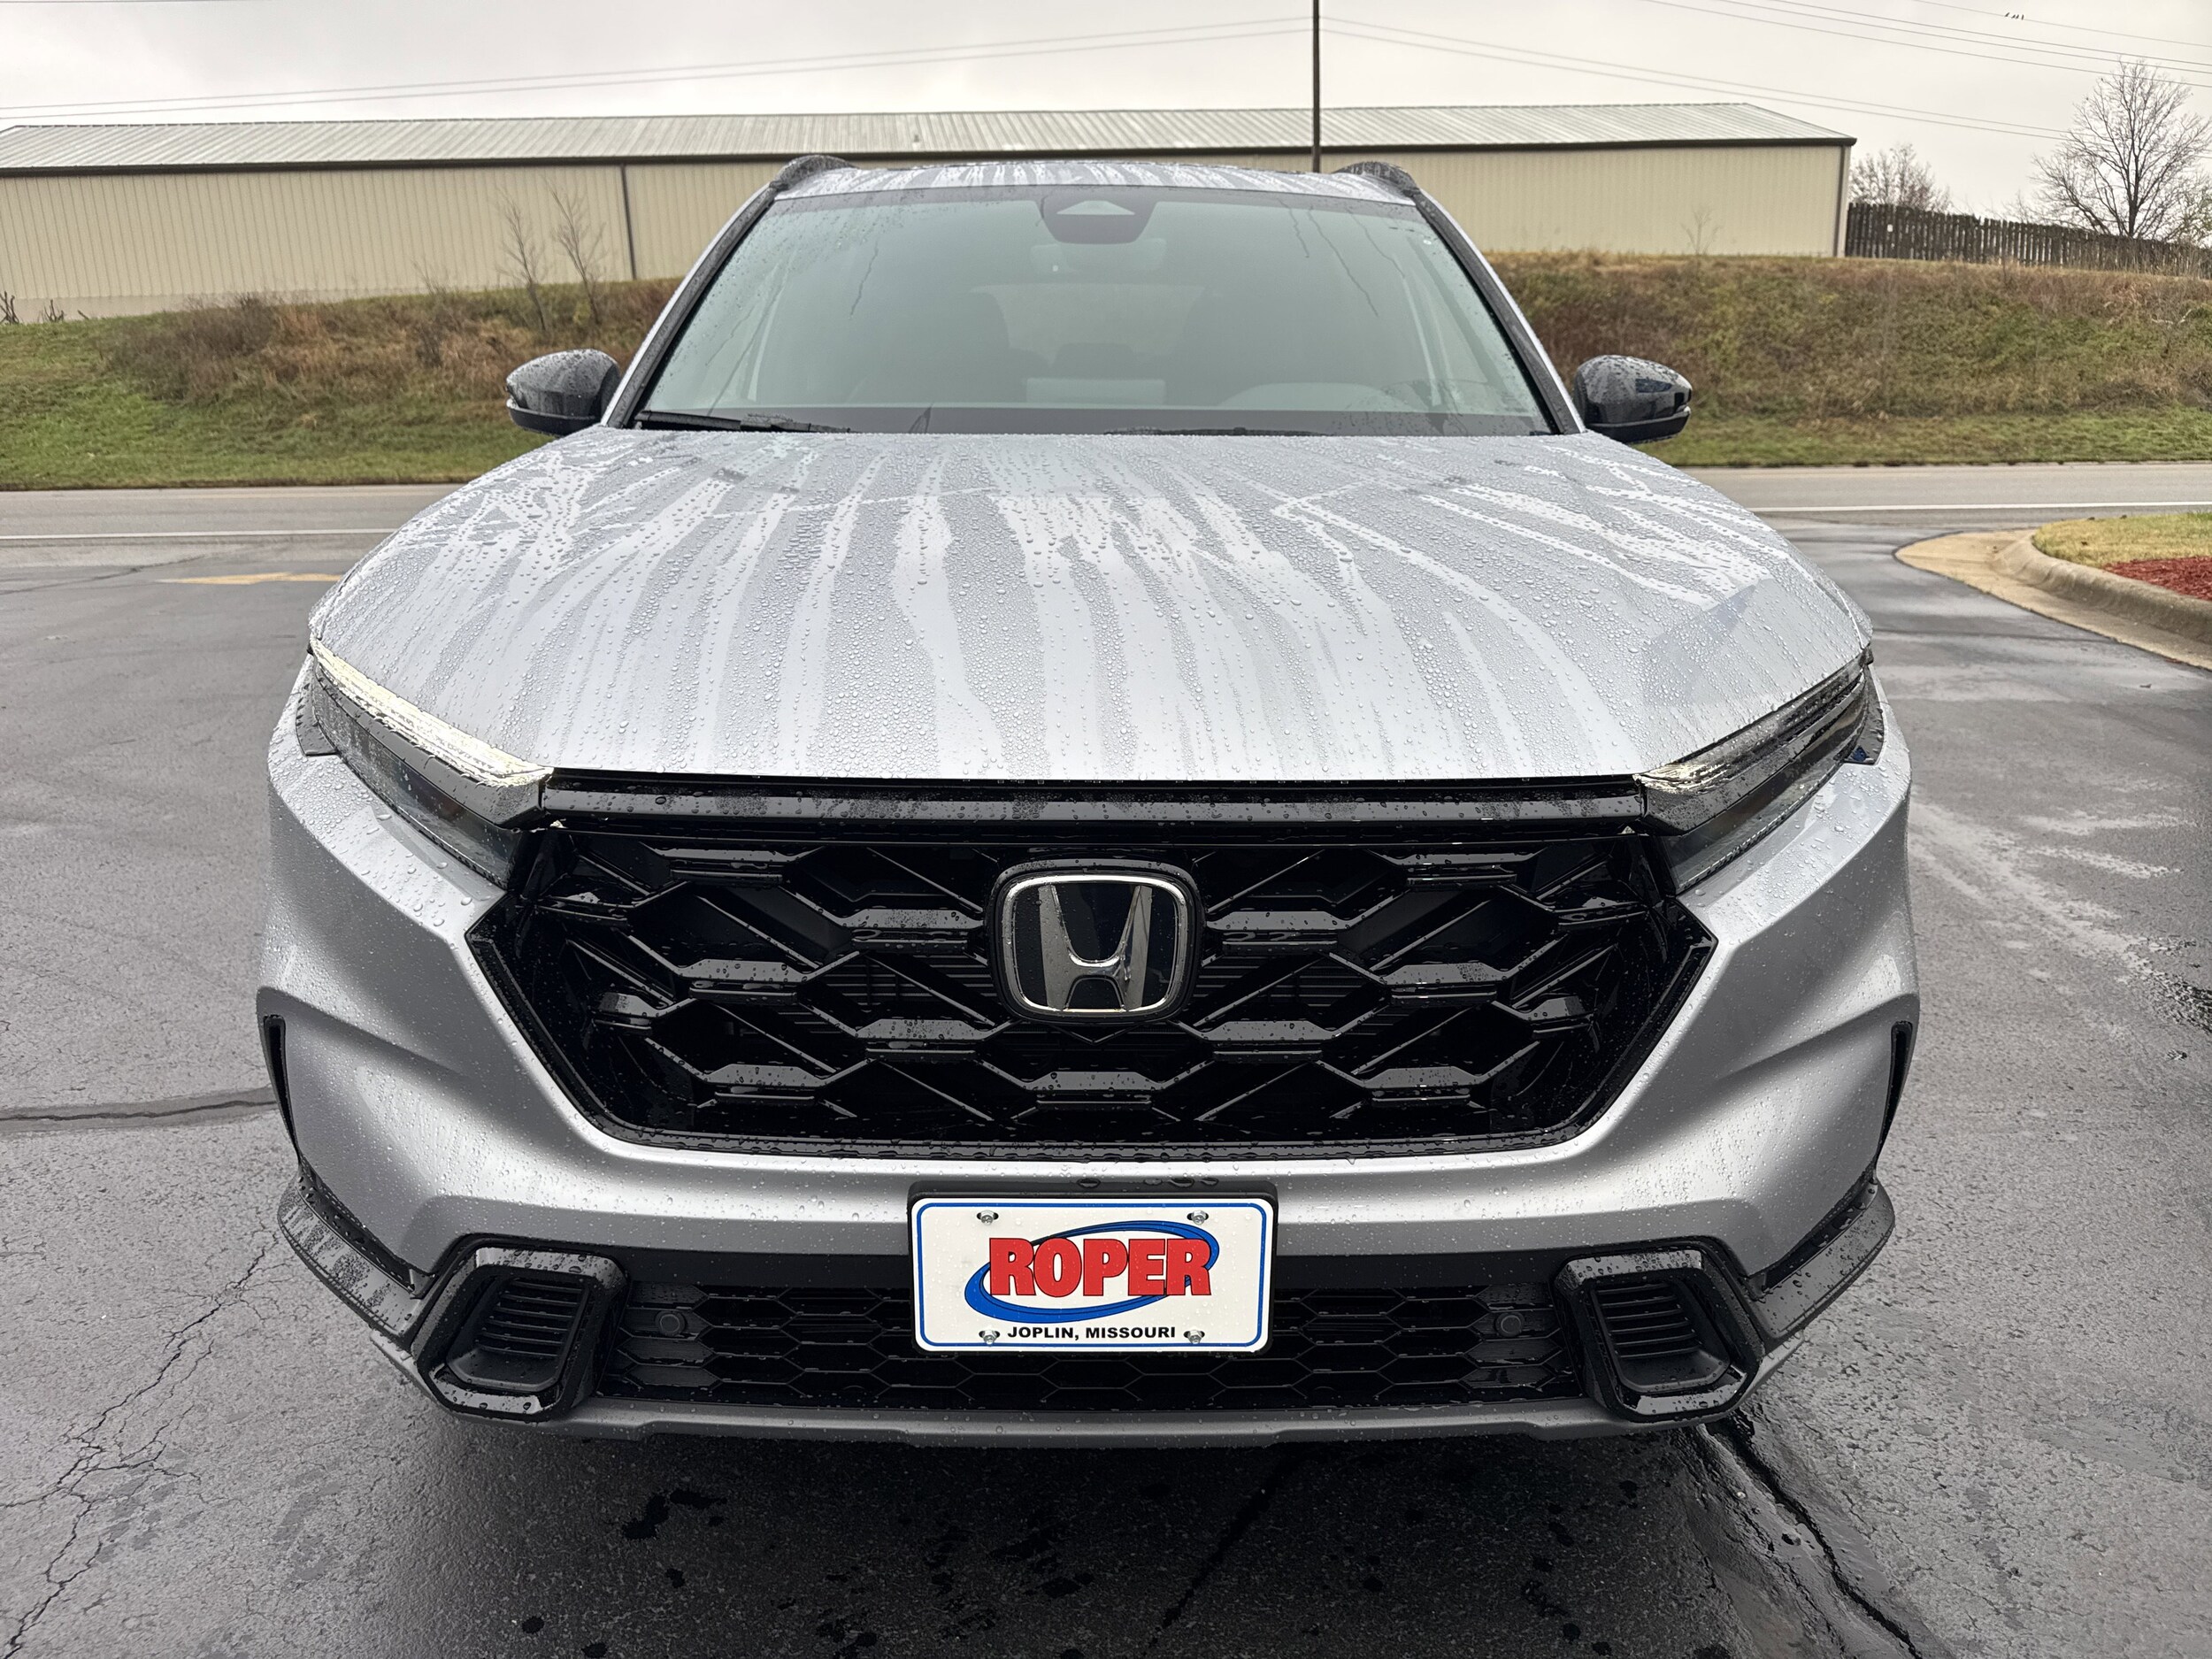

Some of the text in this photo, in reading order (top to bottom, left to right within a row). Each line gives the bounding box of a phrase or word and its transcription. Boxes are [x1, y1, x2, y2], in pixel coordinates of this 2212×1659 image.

[989, 1237, 1212, 1297] ROPER
[1007, 1326, 1176, 1341] JOPLIN, MISSOURI
